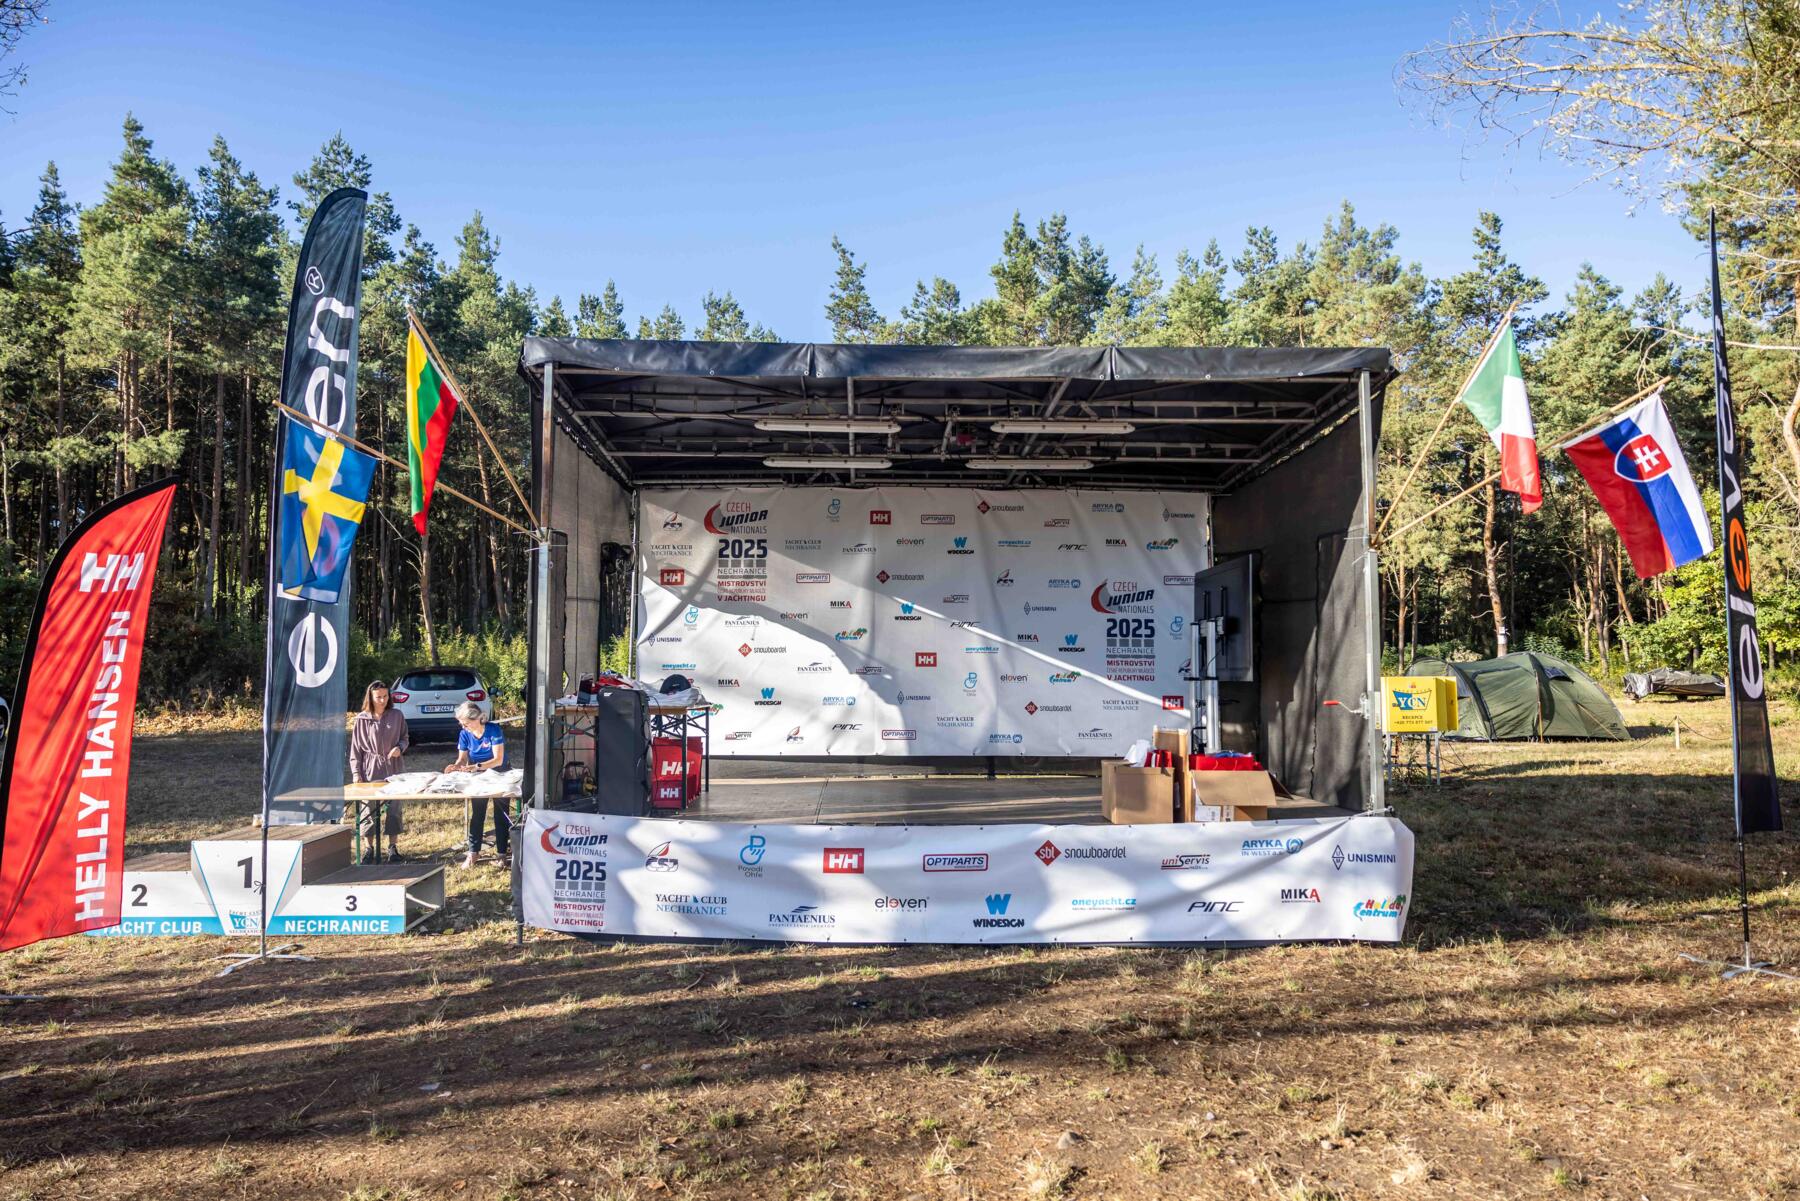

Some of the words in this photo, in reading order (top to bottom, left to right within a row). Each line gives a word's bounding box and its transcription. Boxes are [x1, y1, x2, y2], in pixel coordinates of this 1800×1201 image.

[726, 502, 750, 512] CZECH
[719, 510, 768, 528] JUNIOR
[872, 514, 888, 522] HH
[730, 526, 768, 534] NATIONALS
[1106, 538, 1127, 546] MIKA
[718, 539, 768, 558] 2025
[79, 552, 145, 593] HH
[664, 572, 683, 582] HH
[1113, 582, 1137, 592] CZECH
[1106, 590, 1154, 606] JUNIOR
[1118, 606, 1154, 614] NATIONALS
[1106, 618, 1156, 638] 2025
[1018, 634, 1038, 642] MIKA
[918, 656, 934, 664] HH
[82, 611, 131, 778] HANSEN
[1398, 697, 1426, 708] YCN
[660, 788, 679, 798] HH
[566, 825, 590, 836] CZECH
[558, 835, 608, 847] JUNIOR
[1242, 840, 1284, 848] ARYKA
[569, 846, 607, 858] NATIONALS
[1040, 846, 1054, 858] sbl
[1064, 846, 1126, 858] snowboardel
[75, 794, 111, 922] HELLY
[829, 854, 858, 869] HH
[927, 857, 984, 866] OPTIPARTS
[1161, 854, 1210, 867] uniServis
[1348, 853, 1396, 864] UNISMINI
[237, 857, 252, 888] 1
[556, 860, 606, 881] 2025
[132, 884, 148, 907] 2
[554, 890, 606, 898] NECHRANICE
[656, 894, 690, 903] YACHT
[700, 896, 728, 904] CLUB
[1281, 888, 1320, 902] MIKA
[345, 896, 358, 912] 3
[554, 902, 604, 912] MISTROVSTVÍ
[875, 896, 928, 908] eleven
[1072, 897, 1136, 907] oneyacht.cz
[1187, 902, 1244, 912] PINC
[656, 904, 727, 916] NECHRANICE
[234, 918, 258, 928] YCN
[768, 914, 836, 924] PANTAENIUS
[973, 918, 1025, 928] WINDESIGN
[103, 920, 156, 934] YACHT
[162, 922, 202, 932] CLUB
[284, 920, 390, 932] NECHRANICE
